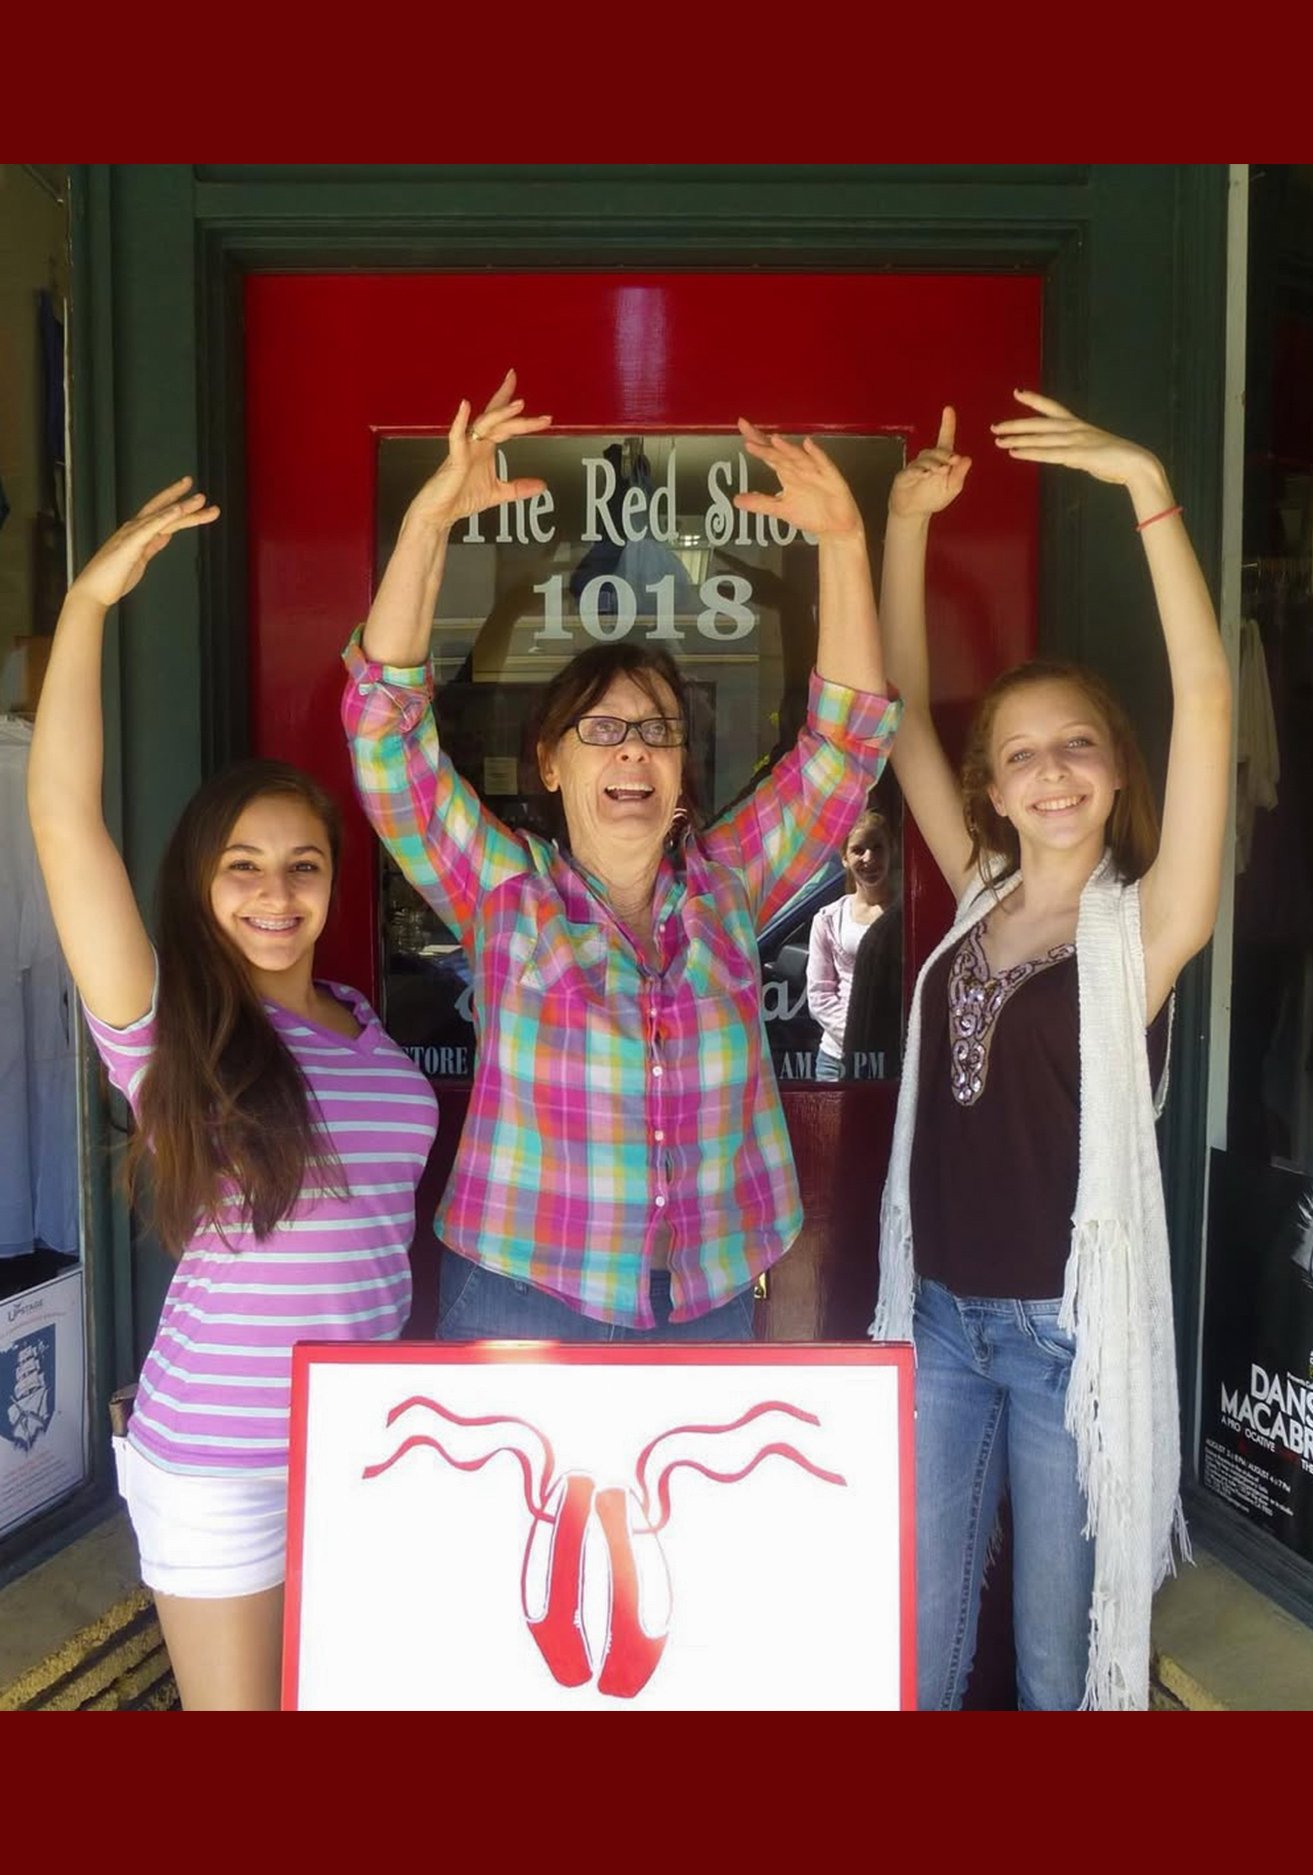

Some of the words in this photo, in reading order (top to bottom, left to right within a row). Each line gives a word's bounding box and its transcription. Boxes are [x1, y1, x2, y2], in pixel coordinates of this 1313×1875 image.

[581, 447, 678, 546] Red
[534, 574, 755, 641] 1018
[402, 1046, 468, 1075] TORE
[780, 1052, 812, 1079] AM
[854, 1052, 885, 1079] PM
